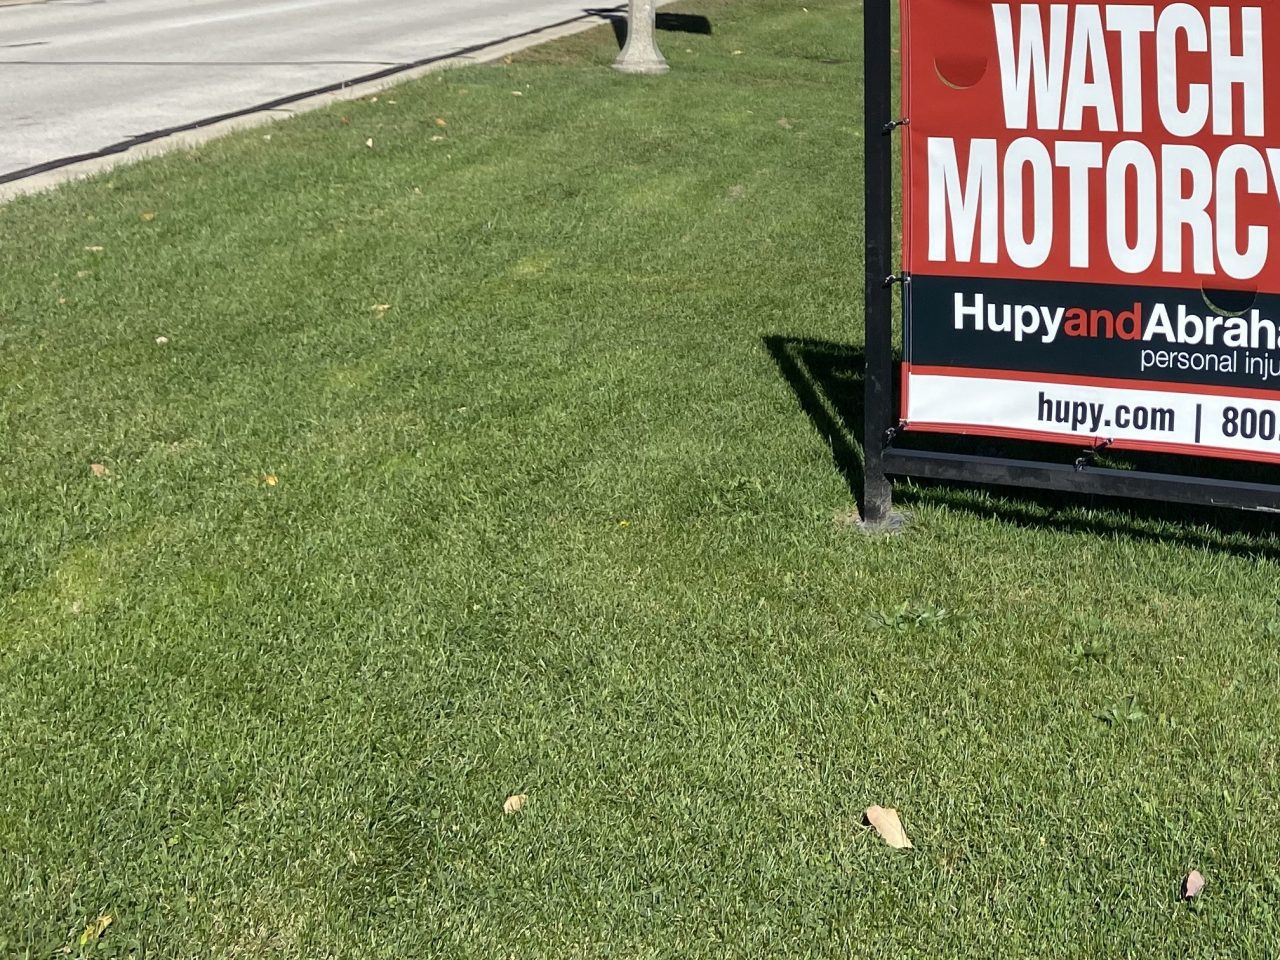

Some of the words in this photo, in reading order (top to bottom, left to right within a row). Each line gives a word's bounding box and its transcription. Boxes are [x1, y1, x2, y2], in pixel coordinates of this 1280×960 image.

[991, 2, 1265, 138] WATCH
[1140, 348, 1238, 373] personal
[1037, 391, 1176, 433] hupy.com
